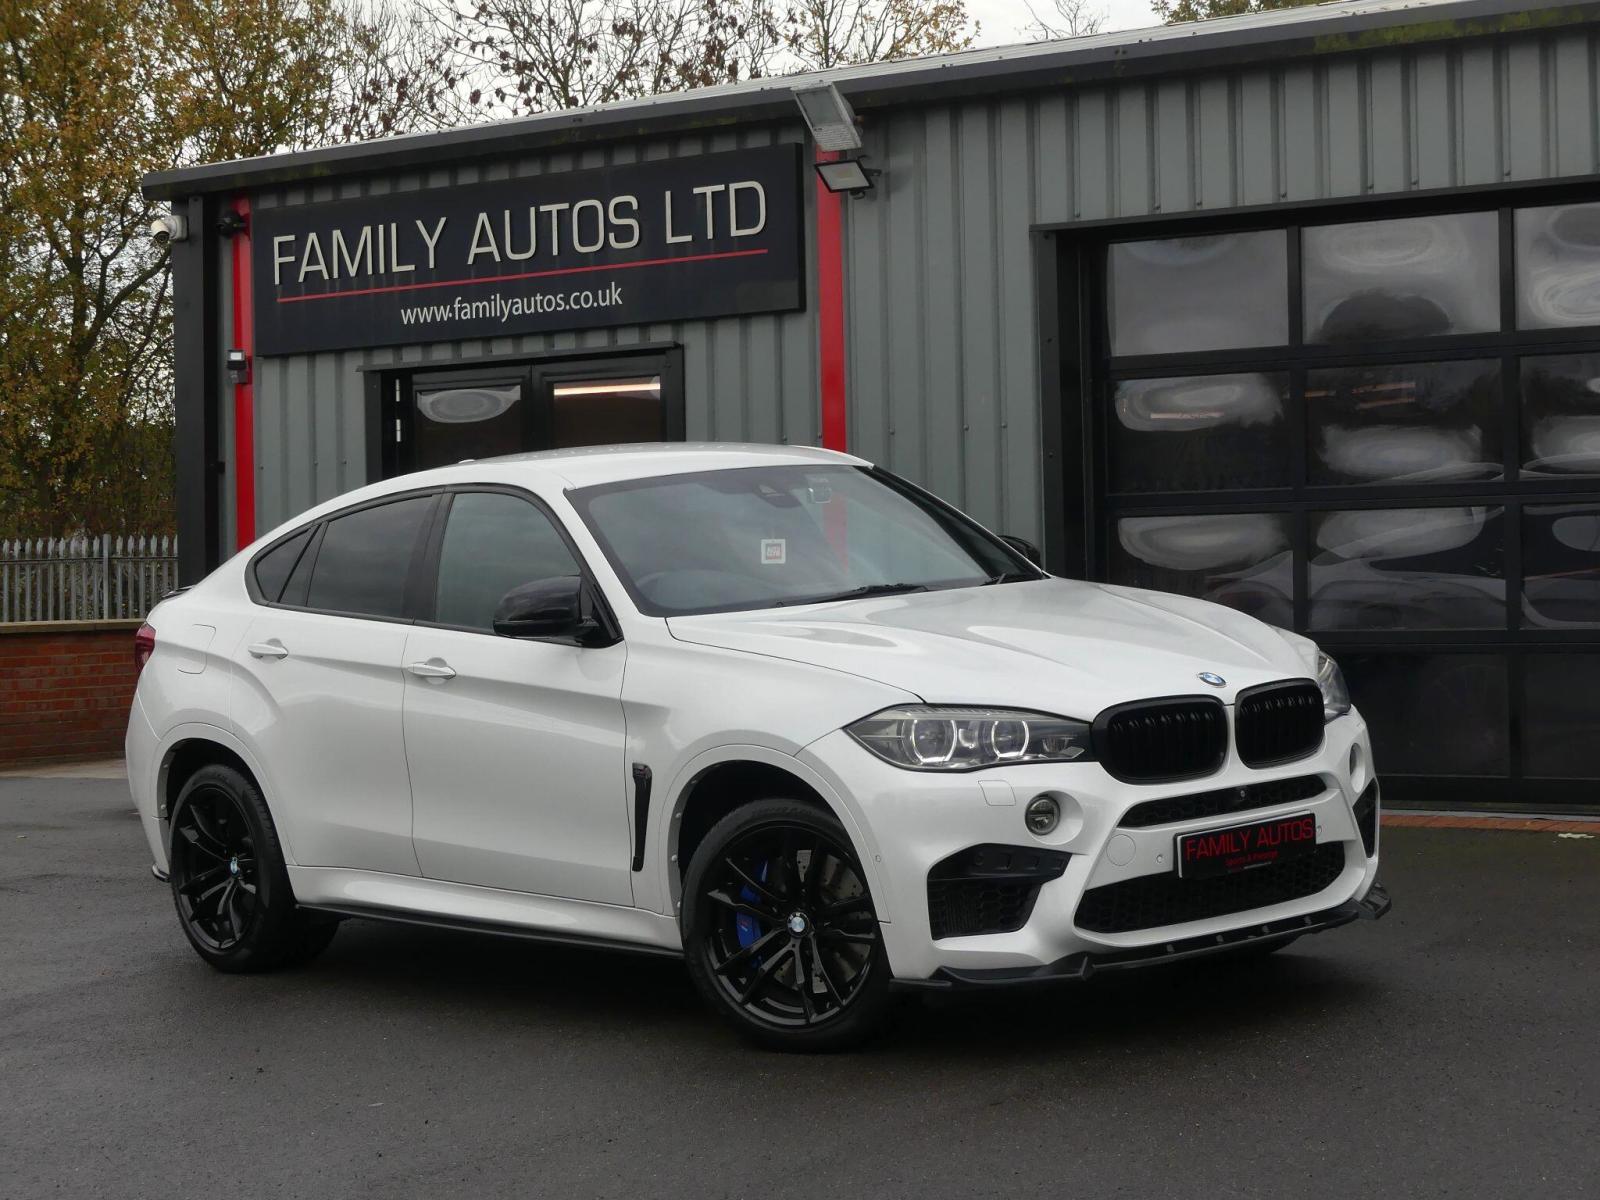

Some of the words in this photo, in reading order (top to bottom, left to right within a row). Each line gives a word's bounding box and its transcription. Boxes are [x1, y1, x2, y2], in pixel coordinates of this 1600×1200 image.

[273, 217, 447, 285] FAMILY
[467, 195, 641, 265] AUTOS
[665, 180, 767, 244] LTD
[400, 281, 623, 325] www.familyautos.co.uk
[1185, 830, 1252, 861] FAMILY
[1257, 818, 1314, 848] AUTOS
